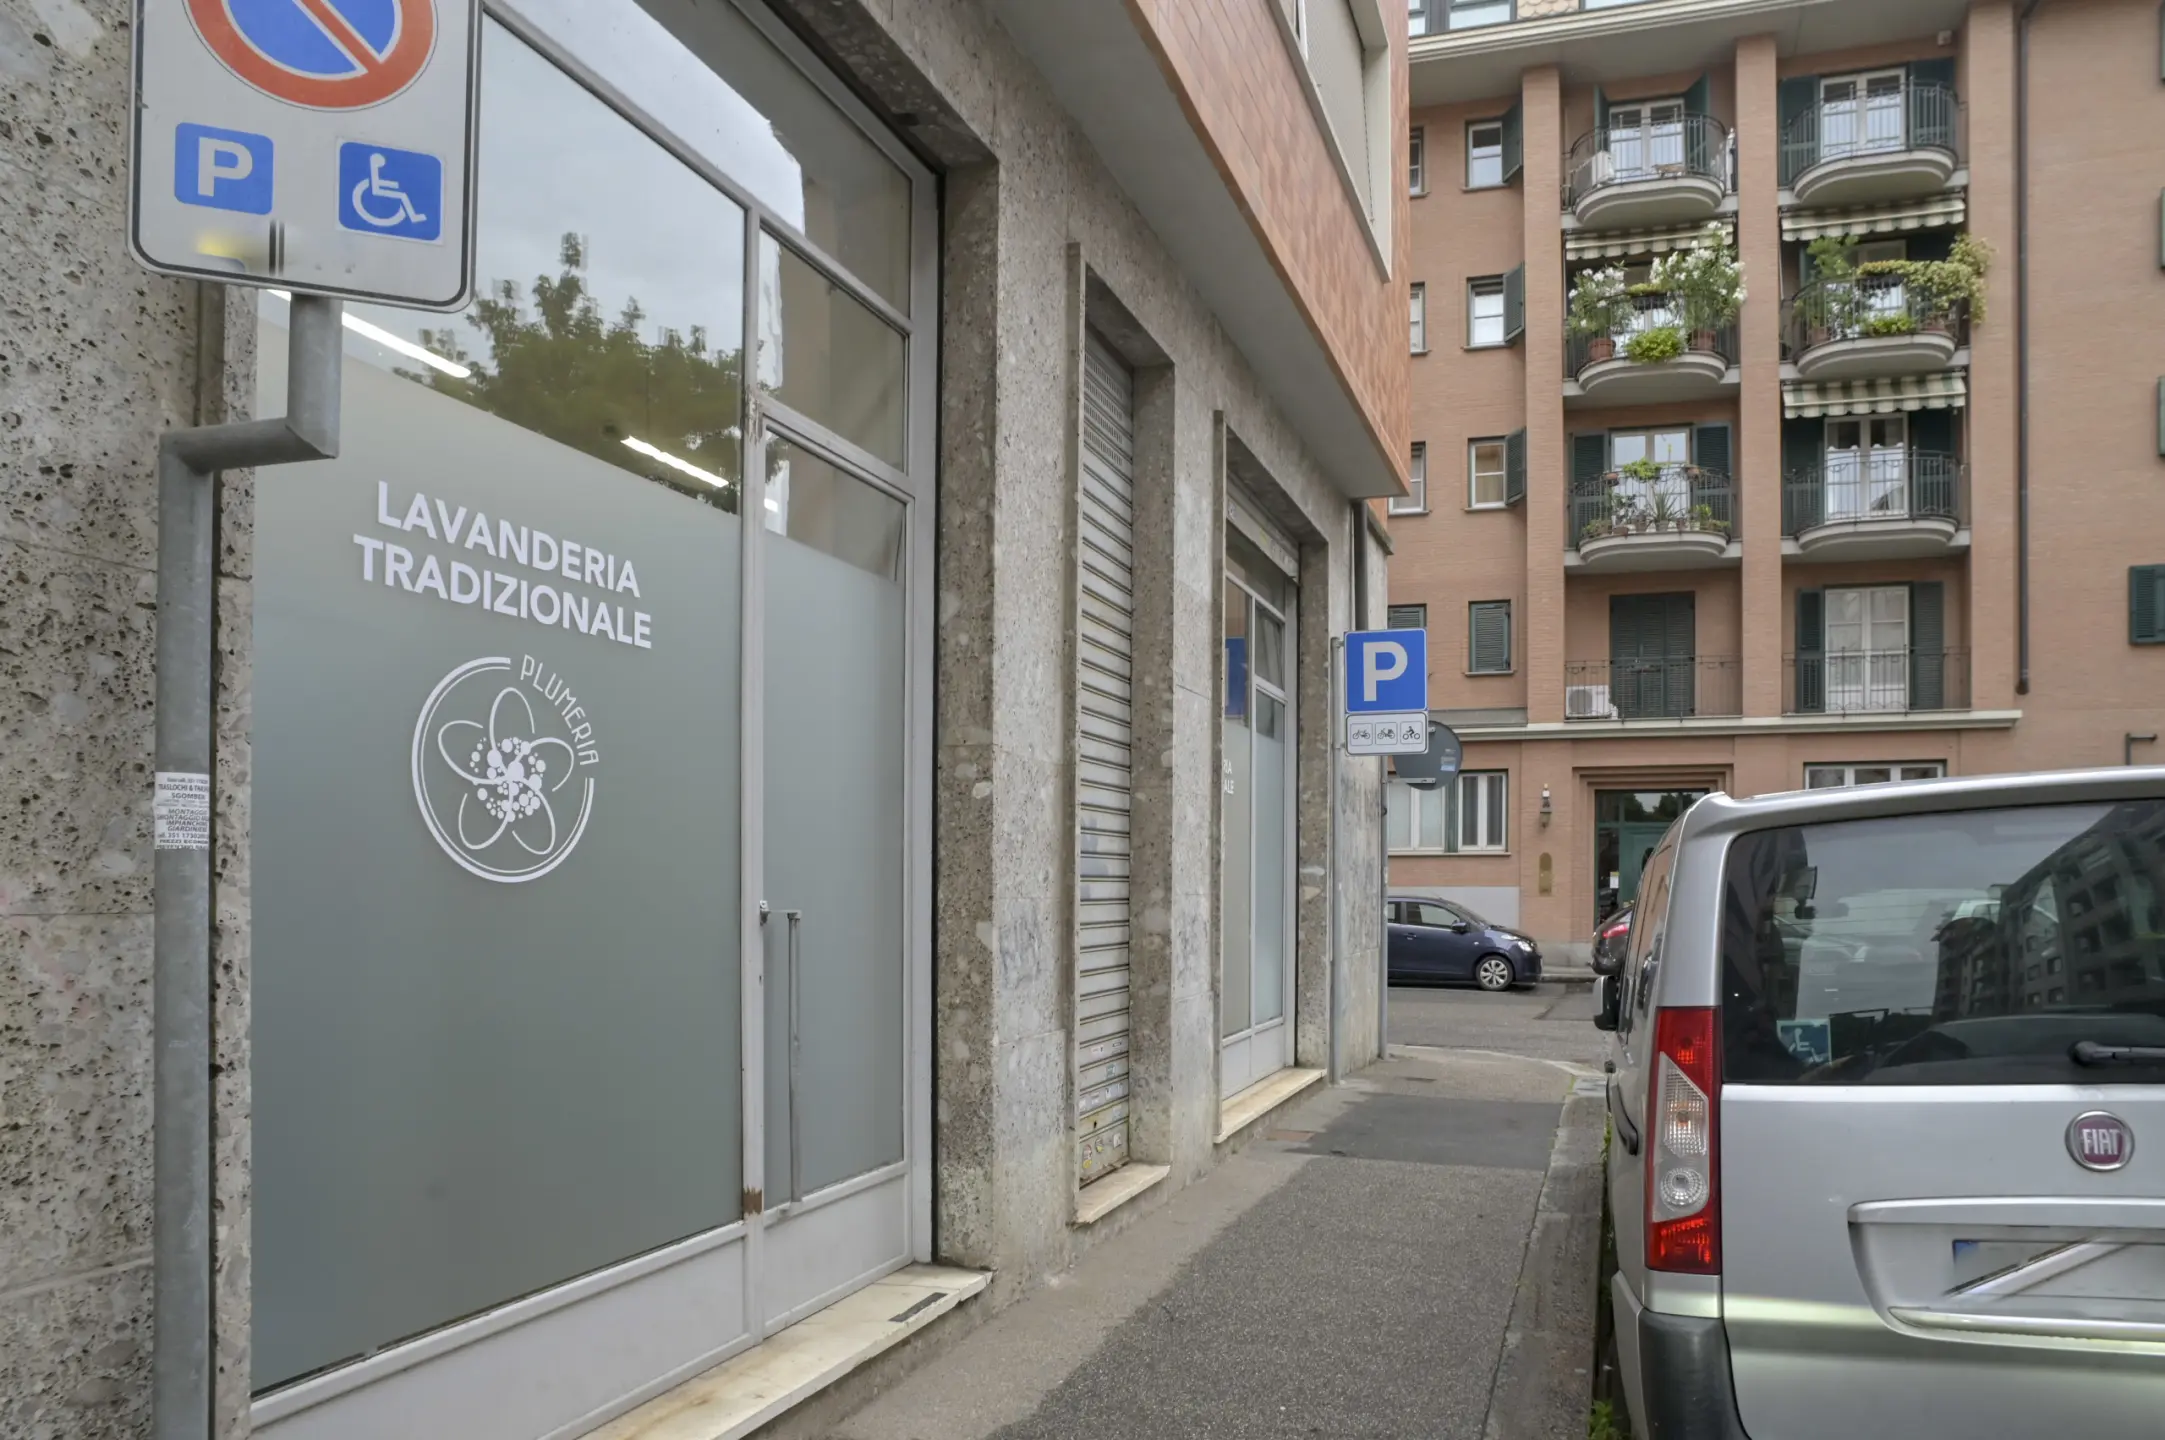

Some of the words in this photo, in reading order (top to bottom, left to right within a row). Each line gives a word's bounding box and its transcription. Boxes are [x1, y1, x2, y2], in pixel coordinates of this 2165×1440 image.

[198, 136, 253, 197] P
[378, 480, 641, 598] LAVANDERIA
[353, 533, 653, 649] TRADIZIONALE
[520, 653, 600, 766] PLUMERIA
[1363, 641, 1408, 702] P
[2082, 1128, 2121, 1155] FIAT
